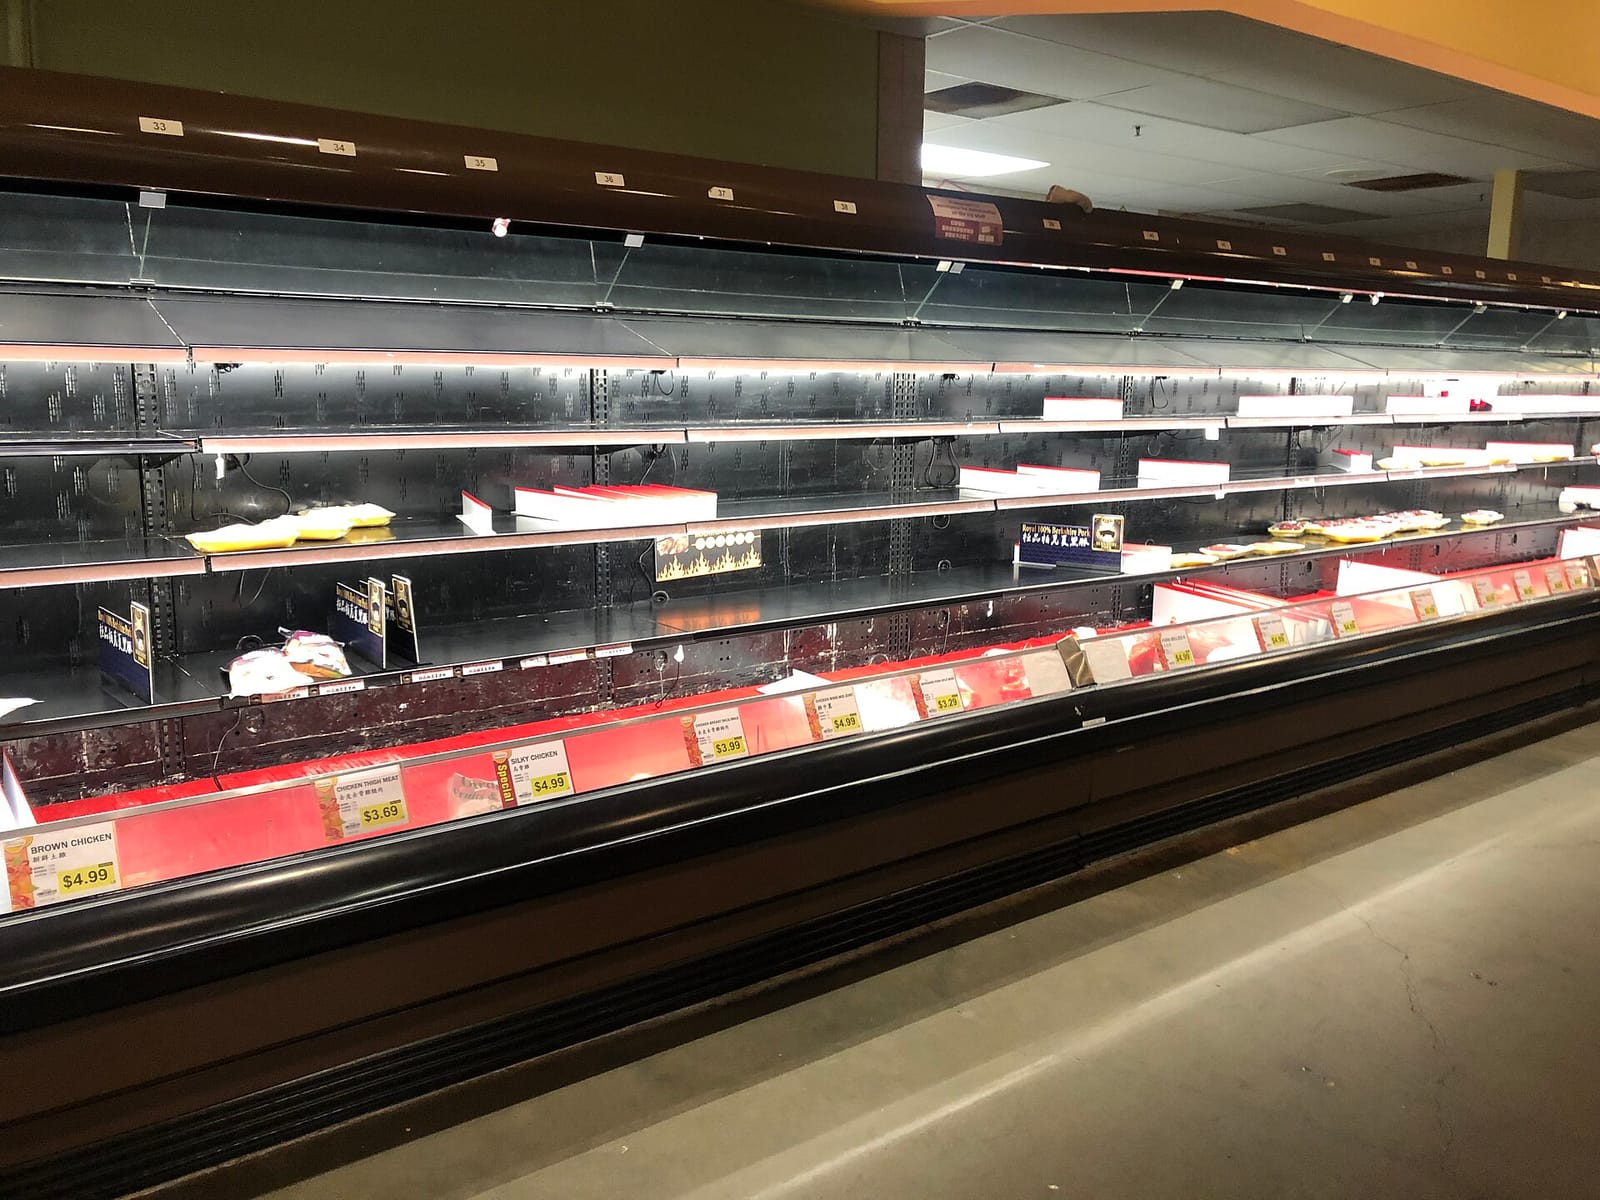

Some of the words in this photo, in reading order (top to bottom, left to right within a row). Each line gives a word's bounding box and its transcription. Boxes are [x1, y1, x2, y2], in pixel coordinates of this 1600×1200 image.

[153, 121, 167, 132] 33
[333, 143, 345, 152] 34
[475, 159, 486, 168] 35
[604, 175, 614, 183] 36
[718, 189, 726, 197] 37
[1022, 524, 1037, 533] Royal
[1037, 525, 1051, 534] 100%
[1052, 526, 1077, 536] Berkshire
[1078, 528, 1091, 537] Pork
[937, 697, 958, 710] $3.29
[833, 716, 857, 729] $4.99
[715, 740, 741, 754] $3.99
[510, 755, 530, 765] SILKY
[530, 750, 558, 761] CHICKEN
[336, 782, 363, 793] CHICKEN
[363, 778, 382, 788] THIGH
[382, 775, 399, 784] MEAT
[497, 763, 515, 802] Special
[534, 777, 565, 792] $4.99
[363, 805, 399, 823] $3.69
[30, 840, 69, 855] BROWN
[71, 832, 112, 848] CHICKEN
[63, 868, 108, 889] $4.99
